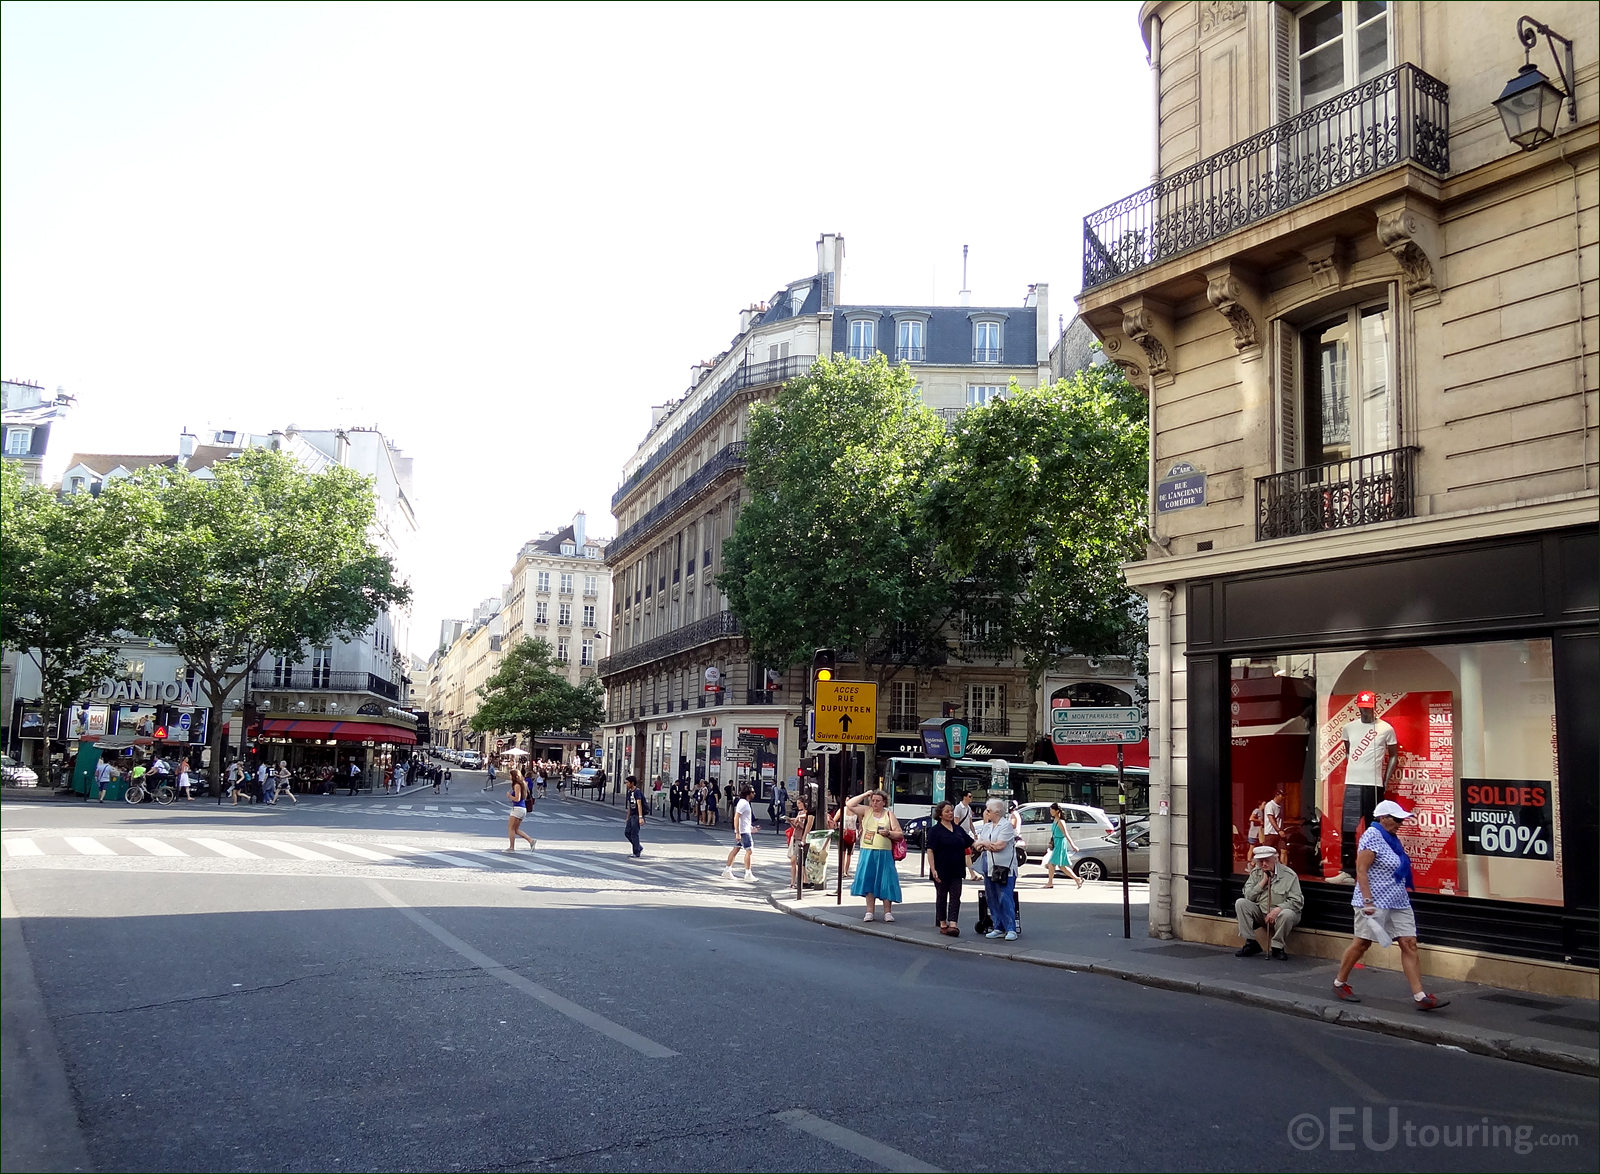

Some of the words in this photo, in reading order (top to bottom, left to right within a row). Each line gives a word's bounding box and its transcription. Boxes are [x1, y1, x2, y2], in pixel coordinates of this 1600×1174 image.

[1174, 482, 1188, 491] RUE
[1159, 494, 1167, 502] DE
[1168, 487, 1202, 499] L'ANCIENNE
[1165, 497, 1195, 508] COMÉDIE
[98, 680, 199, 701] DANTON
[821, 704, 871, 713] DUPUYTREN
[966, 742, 992, 755] Odéon
[1352, 729, 1378, 761] SOLDES
[1467, 786, 1546, 807] SOLDES
[1467, 811, 1517, 825] JUSQU'À
[1468, 824, 1548, 855] -60%
[1405, 846, 1427, 857] SALE
